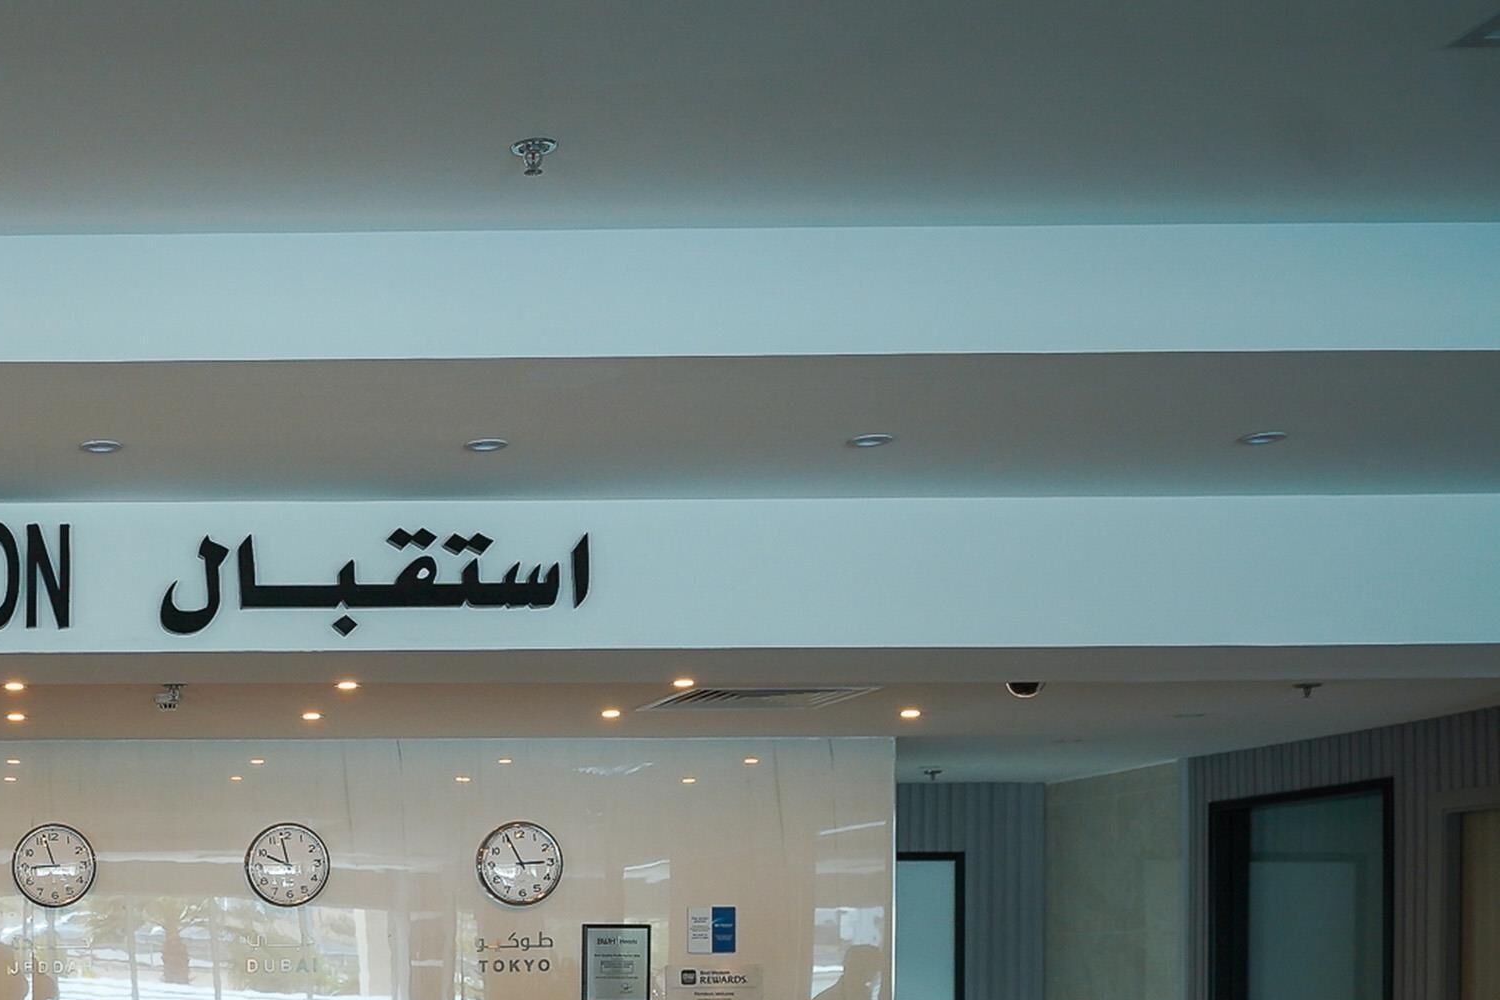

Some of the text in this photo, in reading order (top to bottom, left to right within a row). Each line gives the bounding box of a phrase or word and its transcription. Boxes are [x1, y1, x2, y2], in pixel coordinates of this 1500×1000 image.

[159, 527, 591, 635] استقبال
[48, 833, 59, 841] 12
[281, 831, 292, 840] 2
[300, 835, 303, 843] 1
[36, 837, 43, 845] 11
[67, 836, 70, 844] 1
[269, 836, 276, 845] 11
[25, 849, 34, 857] 10
[258, 849, 267, 857] 10
[308, 845, 316, 853] 2
[492, 847, 500, 855] 10
[314, 859, 322, 867] 3
[546, 858, 554, 866] 3
[260, 877, 268, 885] 8
[37, 888, 43, 896] 7
[66, 887, 74, 895] 5
[272, 887, 278, 895] 7
[301, 886, 308, 894] 5
[533, 884, 541, 892] 5
[52, 891, 59, 900] 6
[286, 890, 294, 898] 6
[475, 932, 553, 953] طوكيو
[246, 958, 317, 974] DUBAI
[479, 958, 550, 972] TOKYO
[700, 976, 746, 984] REWARDS
